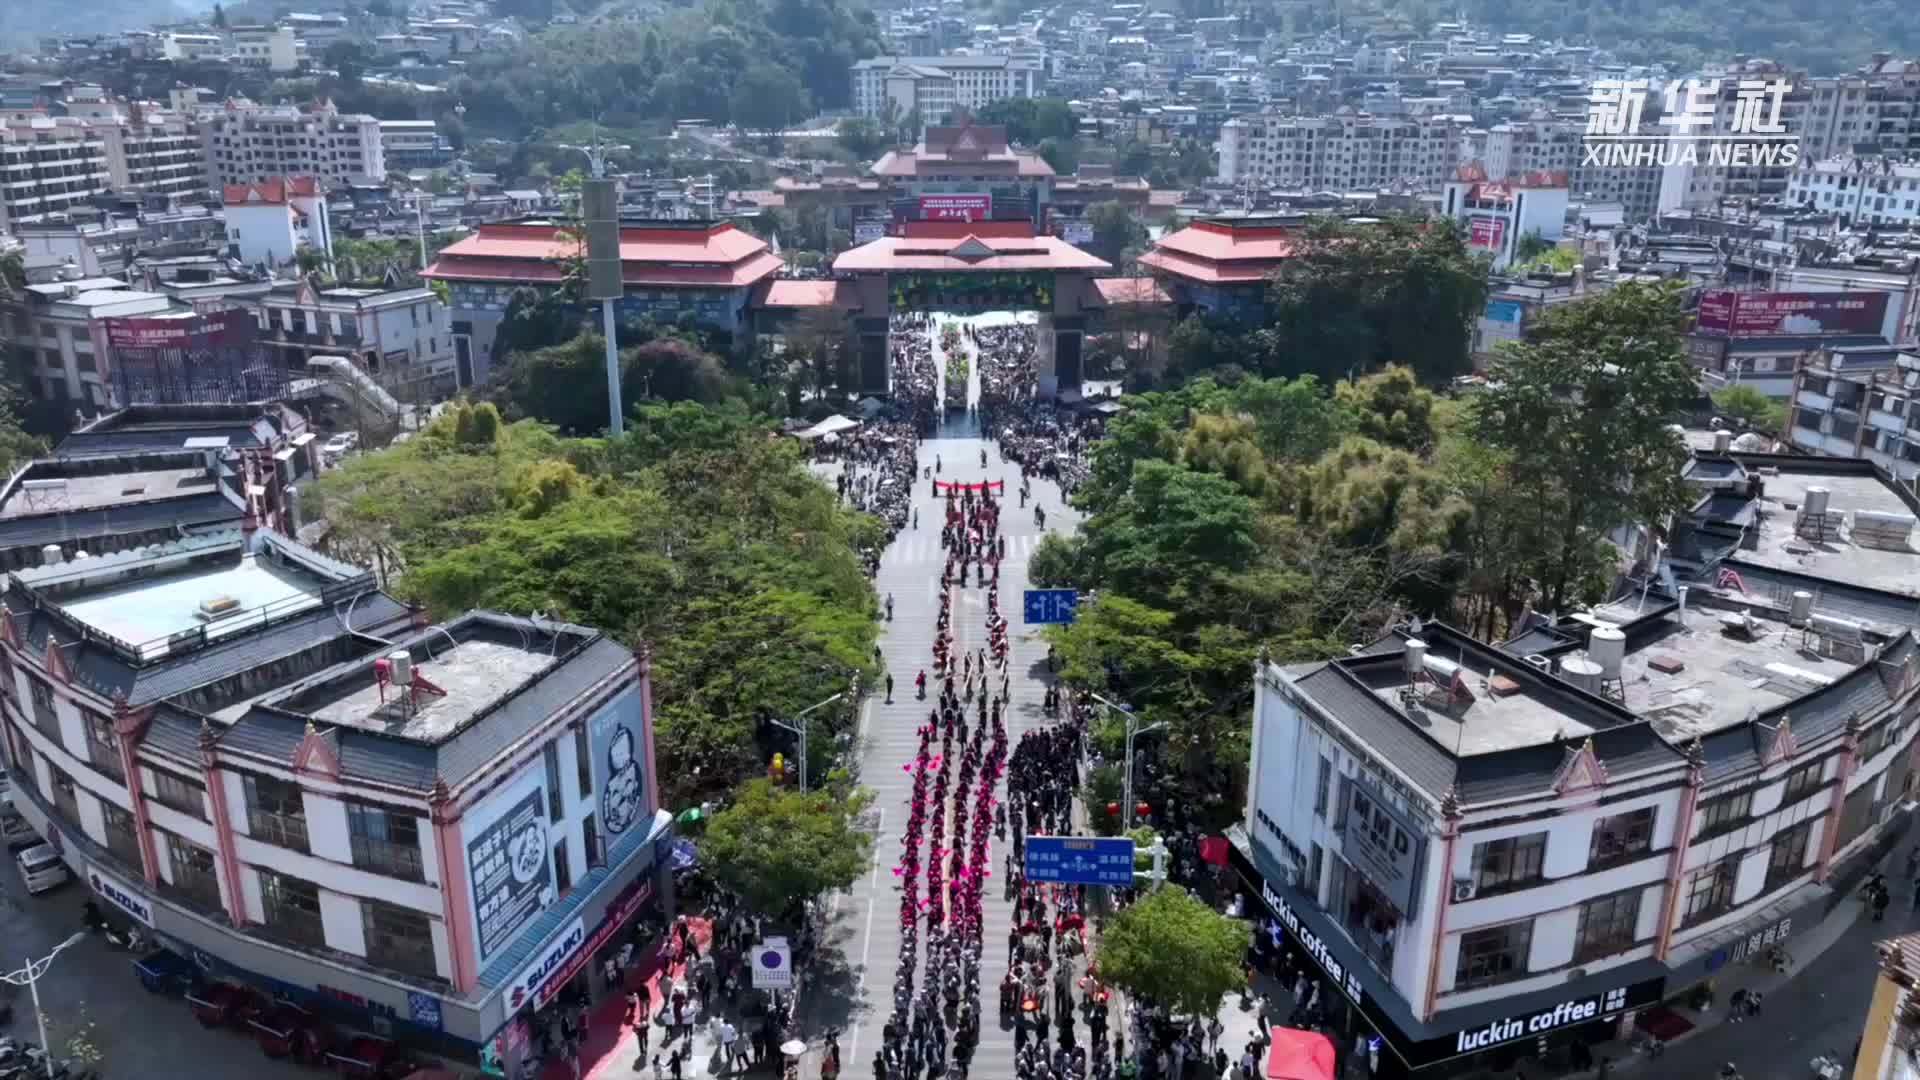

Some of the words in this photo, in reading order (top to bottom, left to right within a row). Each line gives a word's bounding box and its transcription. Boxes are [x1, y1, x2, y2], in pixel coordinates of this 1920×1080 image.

[103, 883, 149, 922] SUZUKI
[1262, 879, 1299, 934] luckin
[1300, 926, 1342, 983] coffee
[527, 927, 583, 991] SUZUKI
[1457, 1018, 1524, 1052] luckin
[1529, 999, 1597, 1033] coffee
